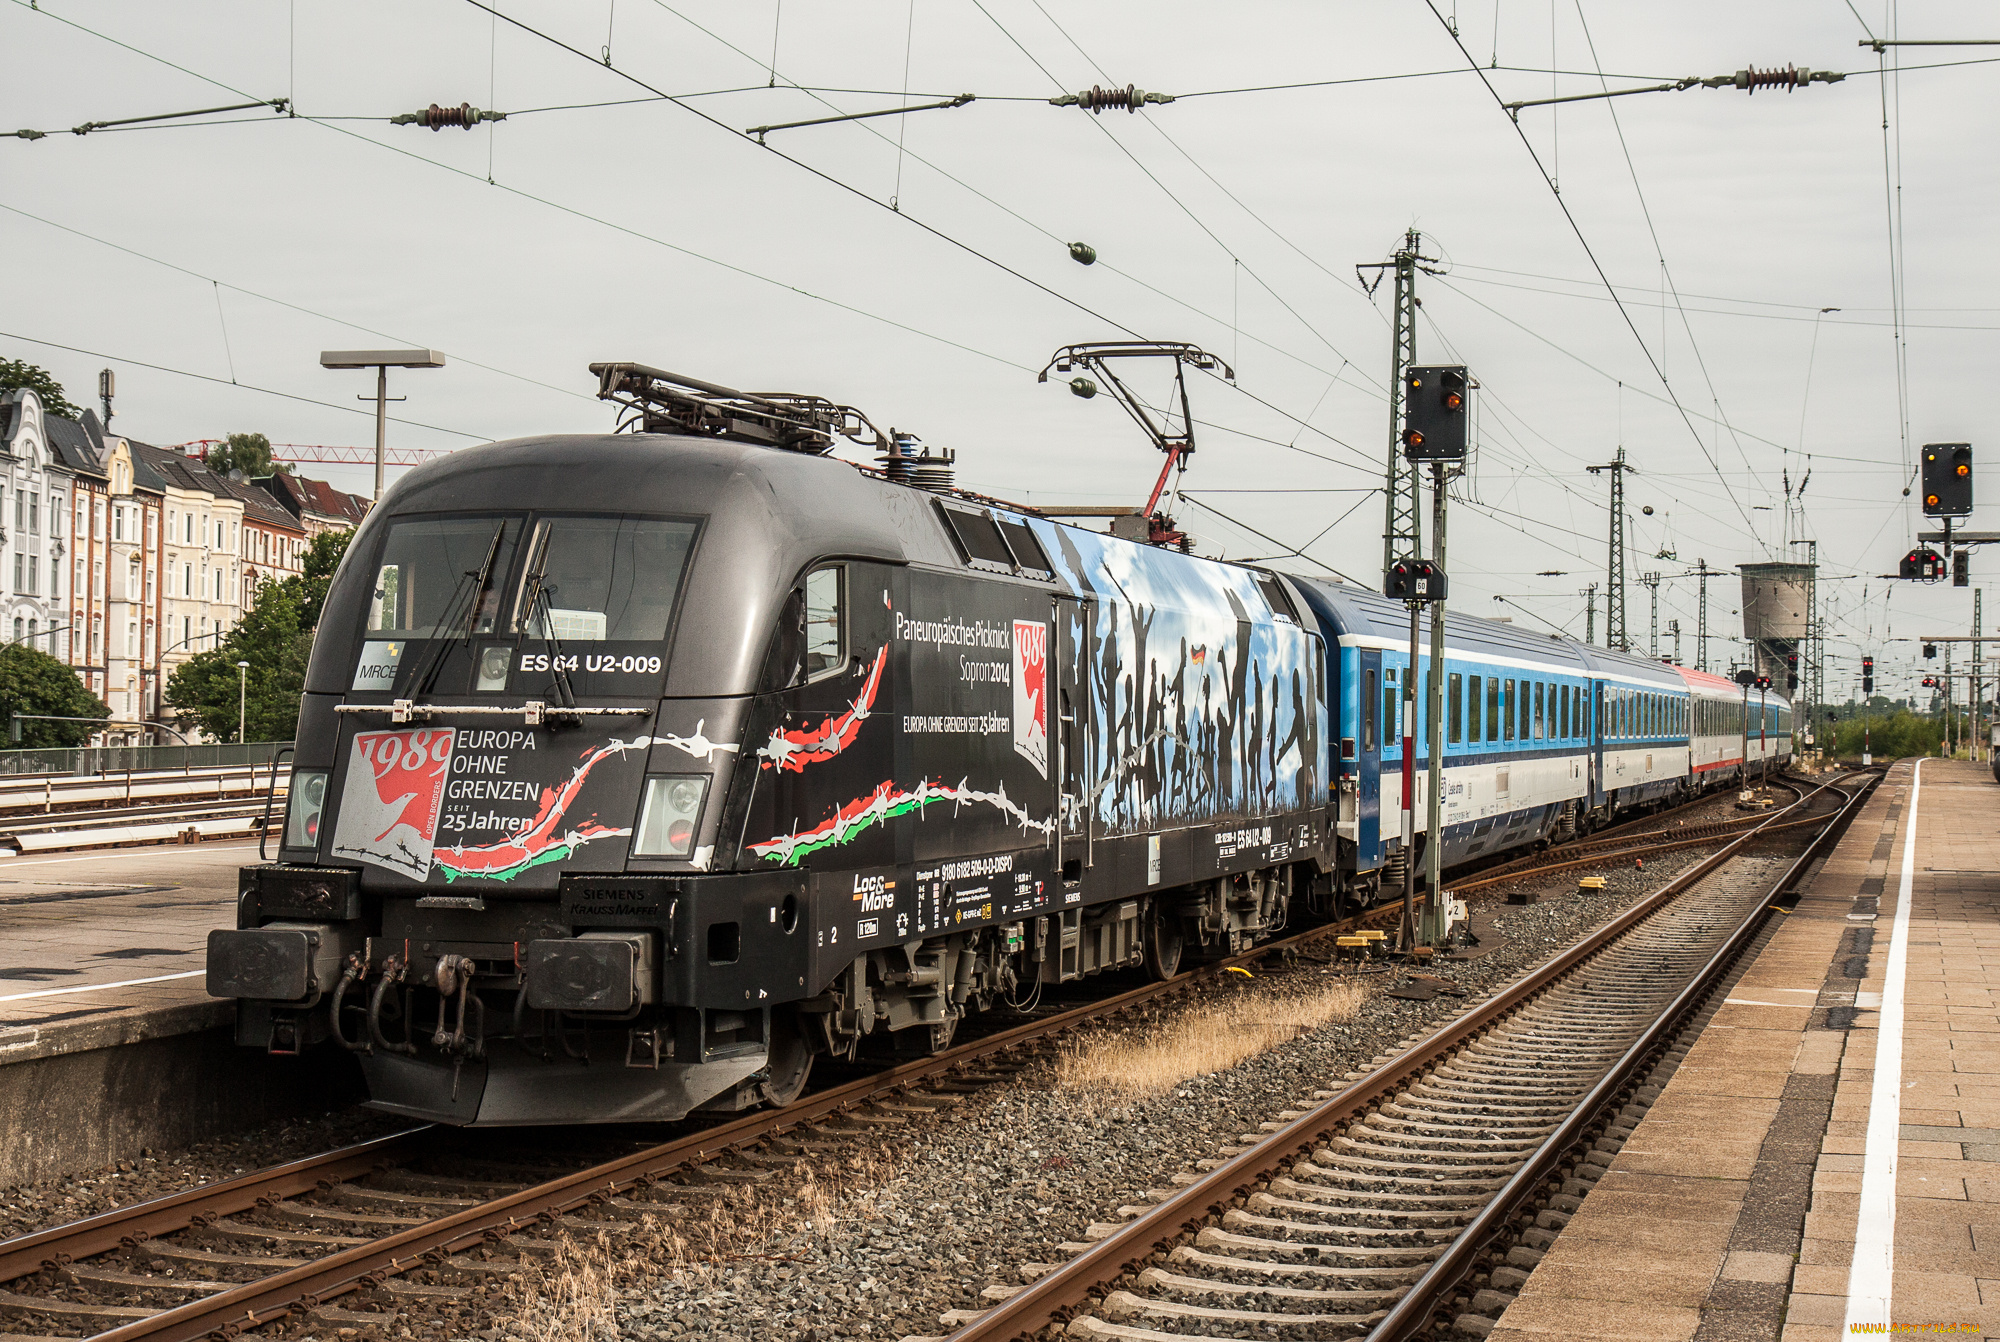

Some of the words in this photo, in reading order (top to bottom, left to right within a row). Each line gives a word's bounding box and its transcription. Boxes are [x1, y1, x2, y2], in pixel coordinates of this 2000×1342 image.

[1417, 582, 1425, 590] 60
[896, 612, 975, 652] Paneuropäisches
[975, 620, 1010, 649] Picknick
[1016, 626, 1046, 674] 1989
[359, 665, 398, 678] MRCE
[520, 654, 549, 672] ES
[552, 654, 579, 673] 64
[585, 654, 662, 674] U2-009
[959, 654, 990, 690] Sopron
[990, 662, 1010, 687] 2014
[903, 716, 927, 733] EUROPA
[928, 716, 943, 733] OHNE
[943, 716, 967, 733] GRENZEN
[457, 730, 536, 750] EUROPA
[363, 729, 453, 780] 1989
[453, 755, 509, 774] OHNE
[429, 780, 443, 814] BORDERS
[448, 780, 540, 801] GRENZEN
[447, 804, 471, 812] SEIT
[425, 813, 436, 835] OPEN
[853, 873, 885, 895] Loc&
[583, 889, 645, 900] SIEMENS
[861, 891, 895, 912] More
[1453, 905, 1459, 915] 2
[830, 926, 838, 944] 2
